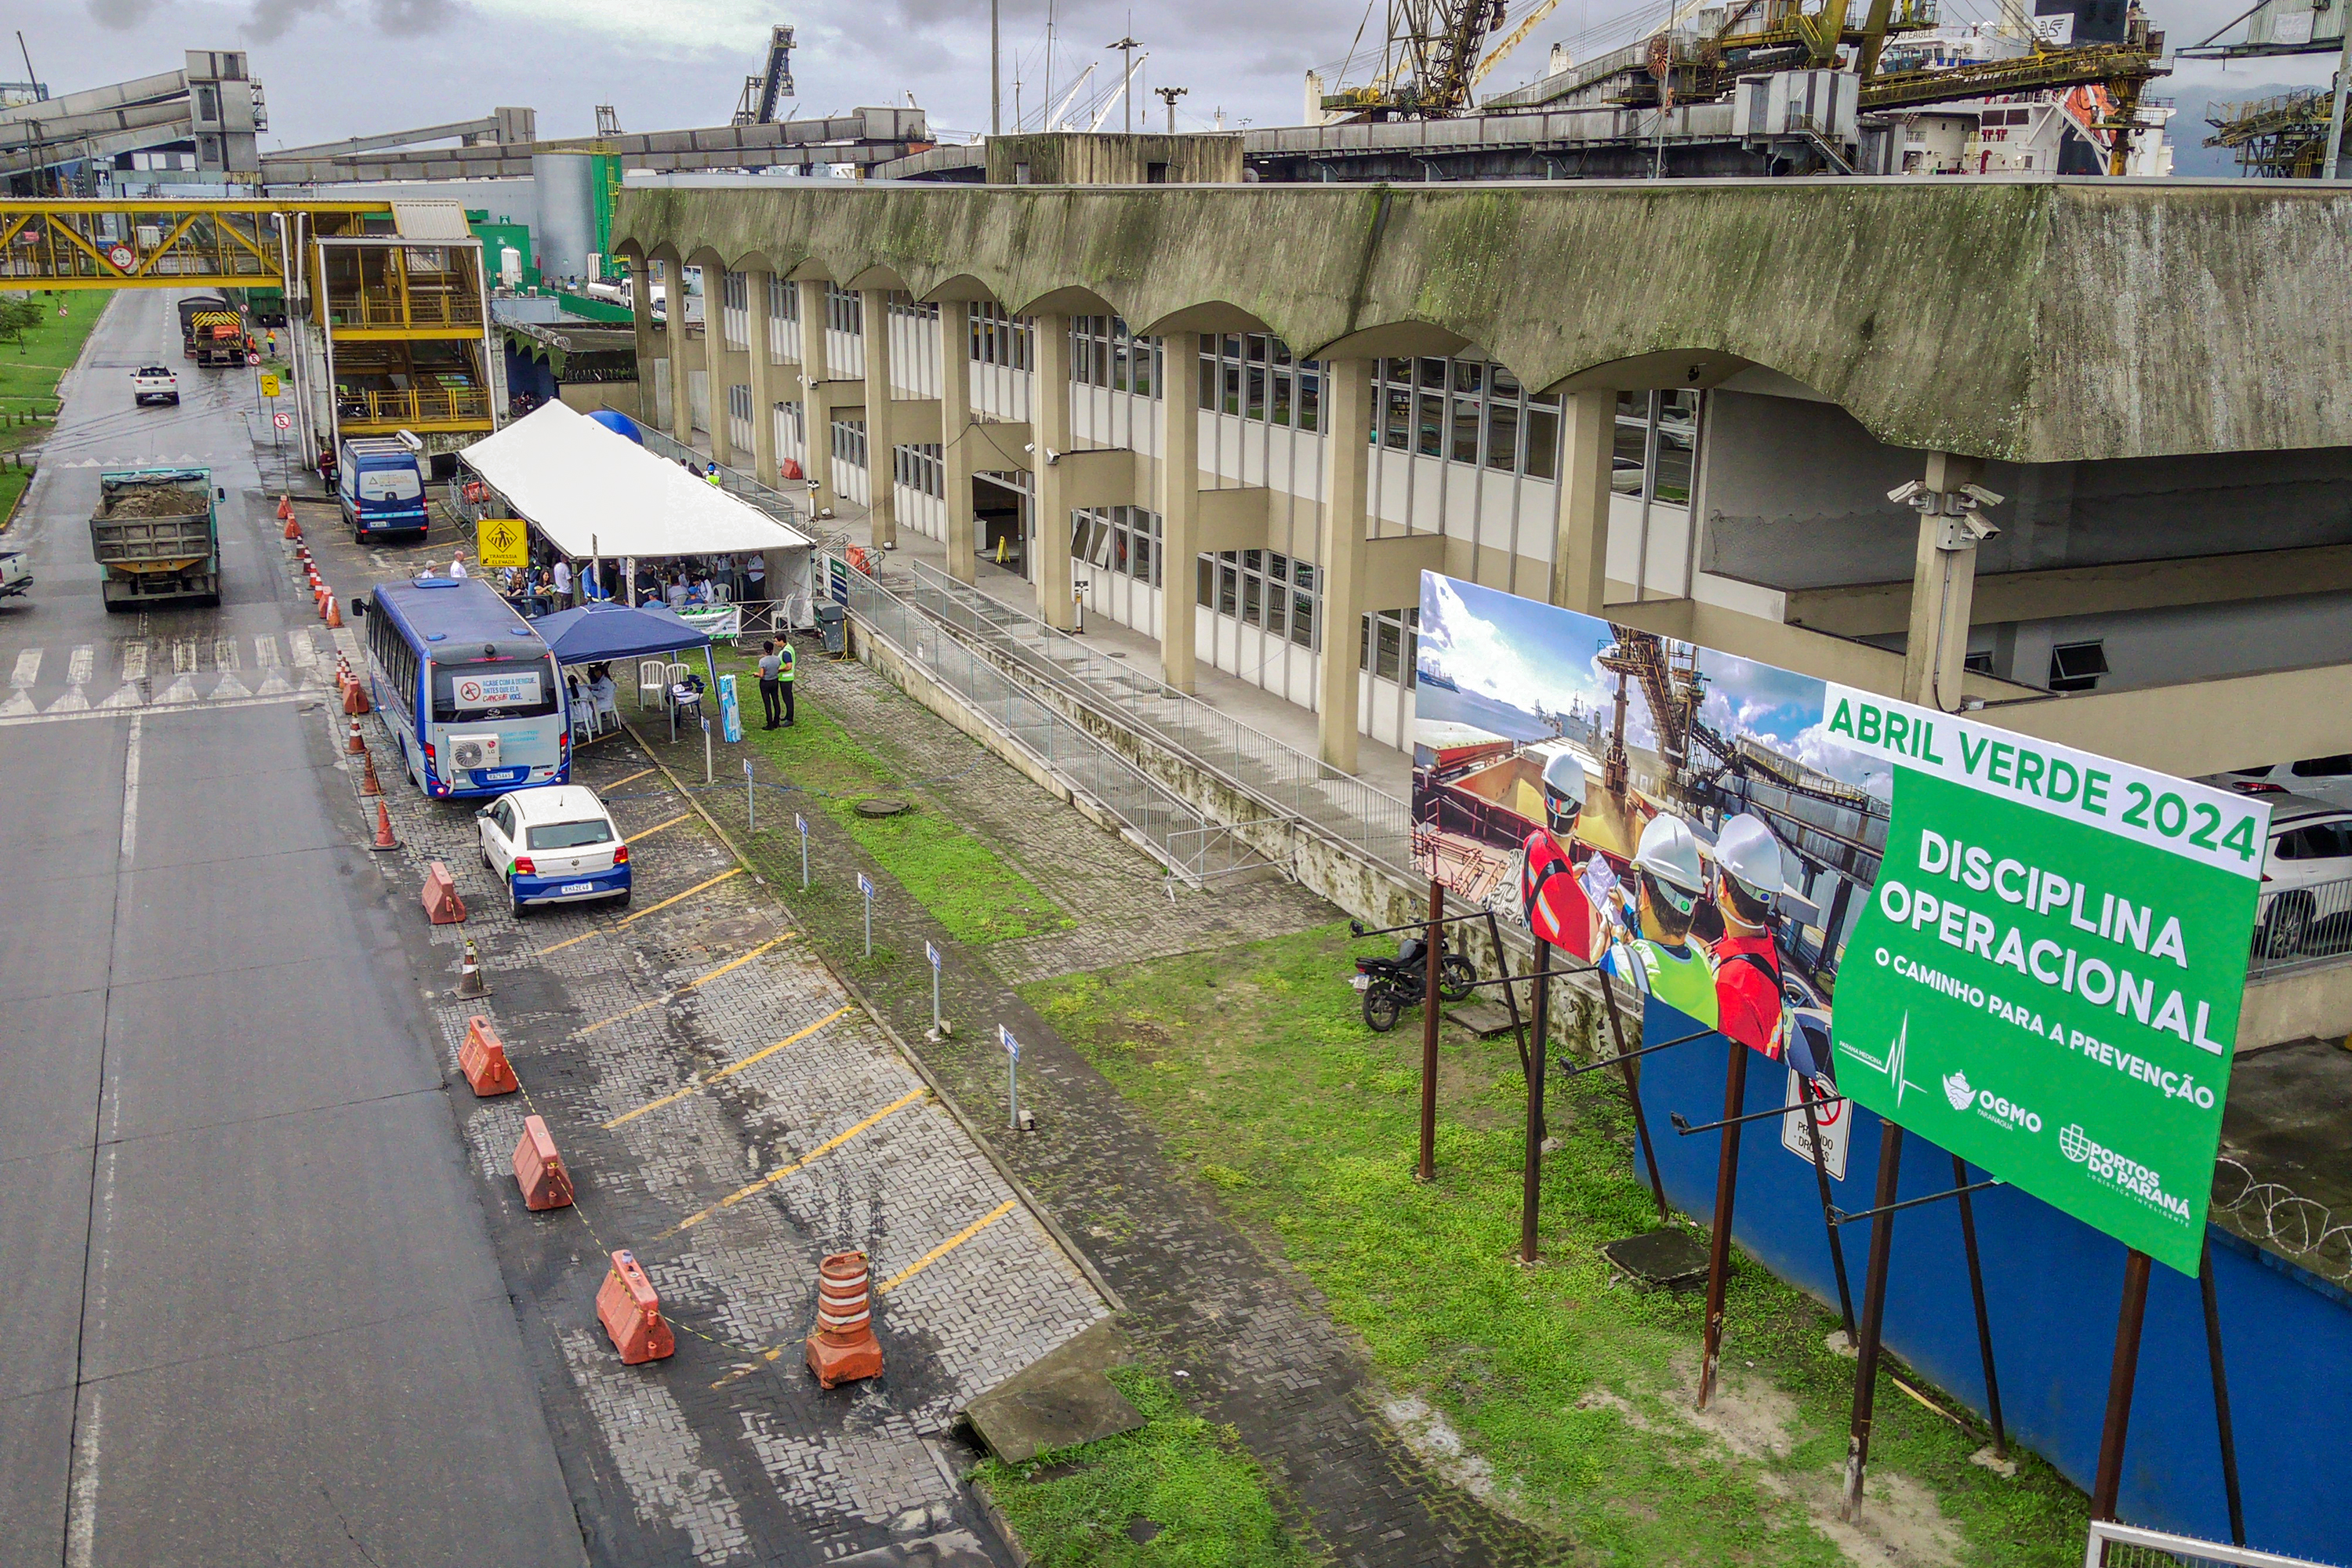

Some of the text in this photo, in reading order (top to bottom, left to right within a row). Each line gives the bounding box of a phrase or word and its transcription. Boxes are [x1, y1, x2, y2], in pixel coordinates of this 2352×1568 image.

[1828, 697, 2256, 862] ABRIL VERDE 2024
[1918, 829, 2188, 969] DISCIPLINA
[1879, 880, 2223, 1056] OPERACIONAL
[1859, 1050, 1882, 1065] MEDICINA
[1875, 947, 2215, 1109] O CAMINHO PARA A PREVENÇÃO
[1977, 1108, 2013, 1131] PARANAGUÁ
[1979, 1090, 2042, 1132] OGMO
[2088, 1156, 2190, 1220] DO PARANÁ
[2090, 1142, 2160, 1187] PORTOS
[2087, 1172, 2190, 1229] LOGÍSTICA INTELIGENTE
